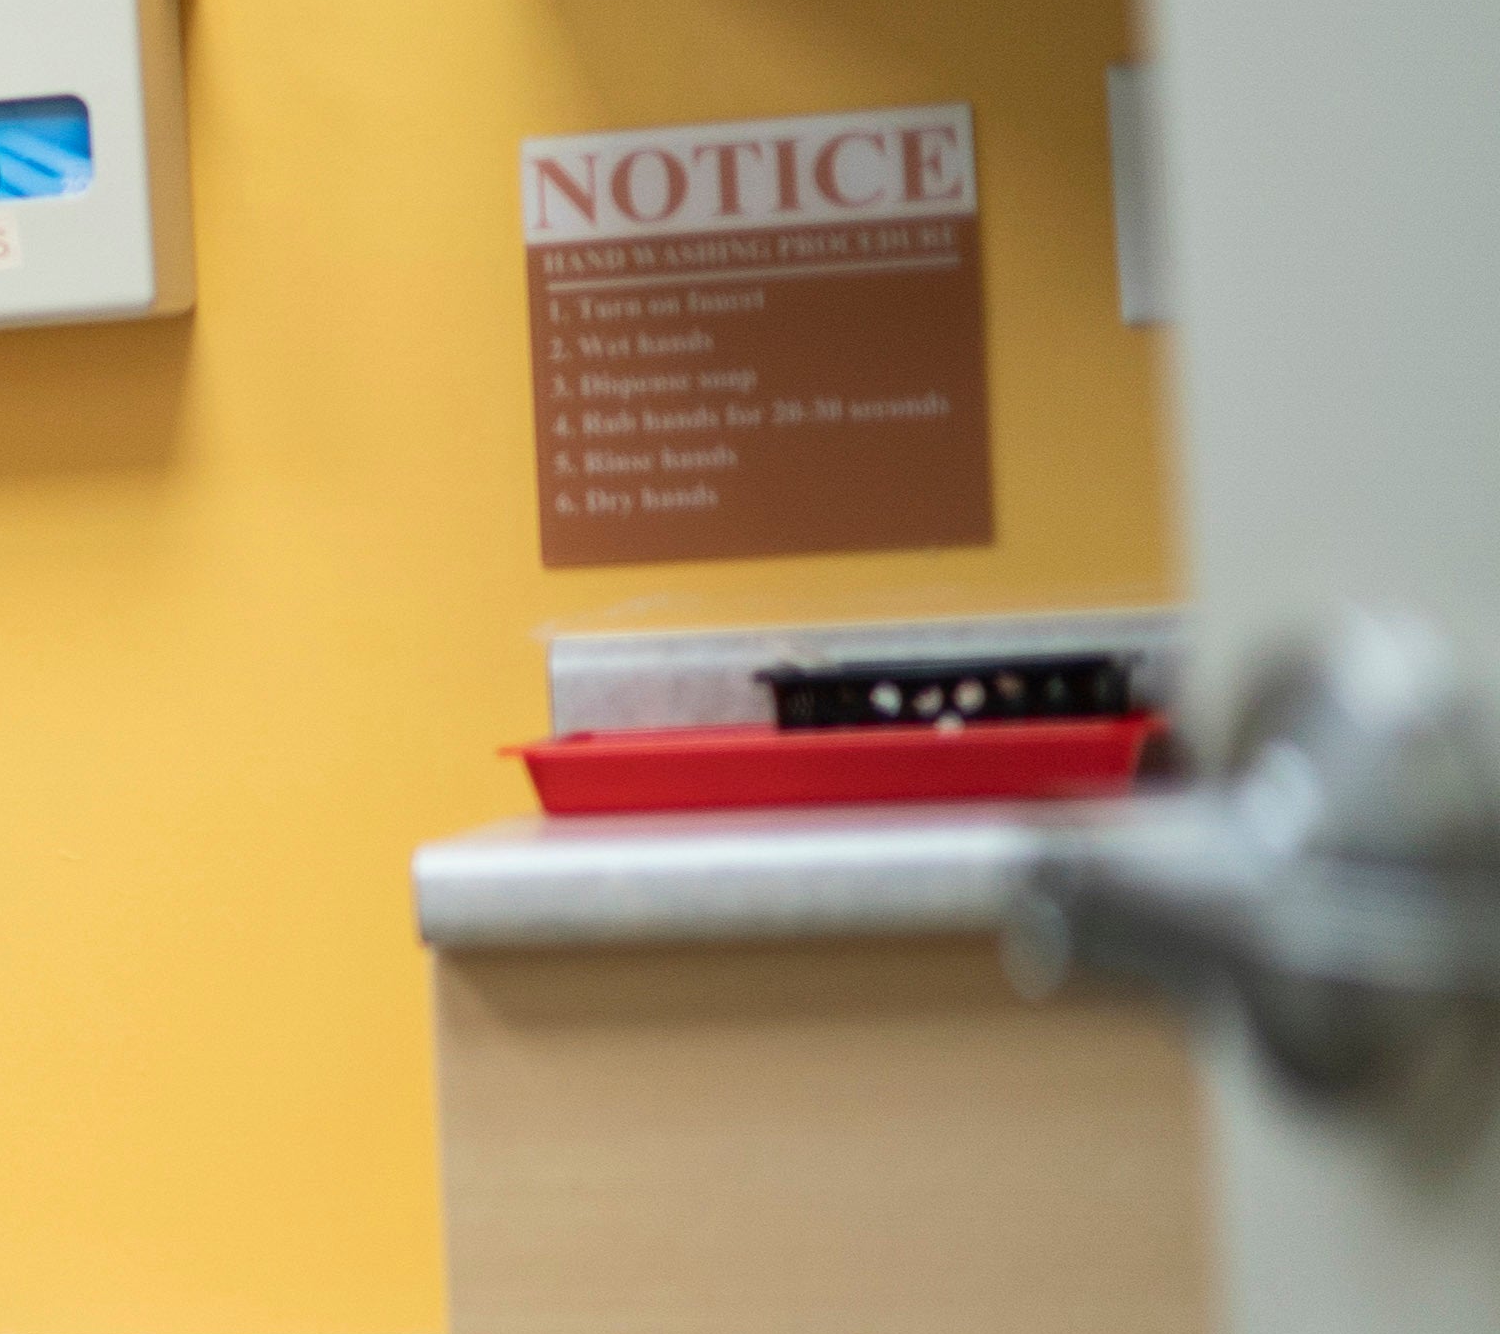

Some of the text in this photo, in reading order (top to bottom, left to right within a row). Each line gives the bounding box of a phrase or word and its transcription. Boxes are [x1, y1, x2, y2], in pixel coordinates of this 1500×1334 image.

[532, 123, 965, 232] NOTICE
[543, 243, 626, 274] HAND
[578, 295, 643, 319] Turn
[578, 334, 631, 358] Wet
[636, 328, 715, 354] hands
[581, 409, 637, 436] Rub
[642, 406, 720, 433] hands
[725, 402, 763, 427] for
[848, 390, 951, 420] seconds
[660, 444, 739, 470] hands
[585, 488, 634, 517] Dry
[640, 484, 720, 511] hands
